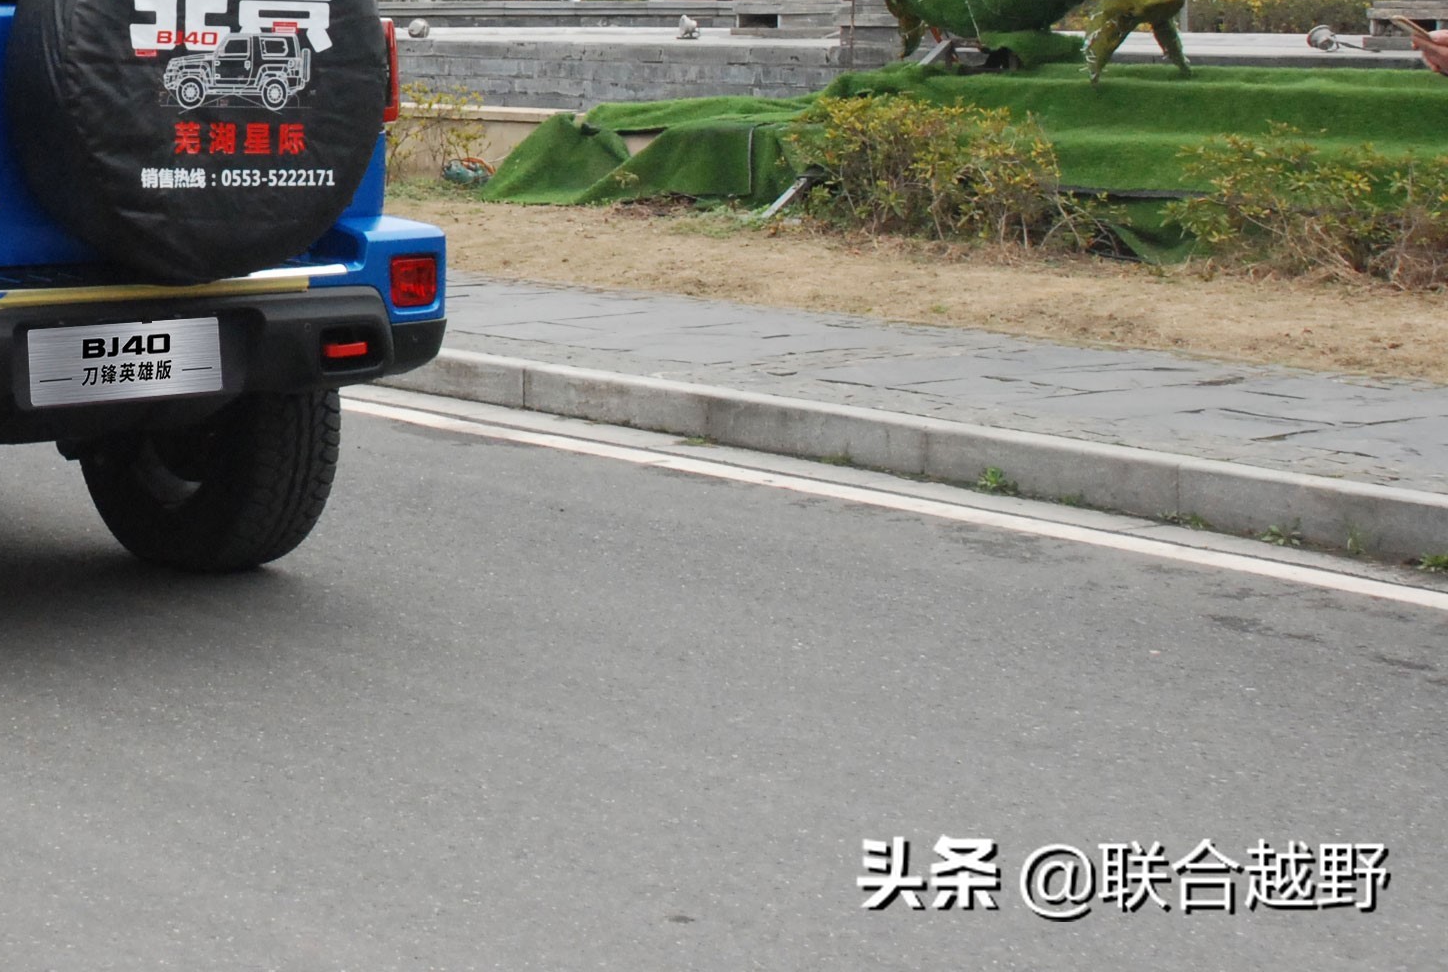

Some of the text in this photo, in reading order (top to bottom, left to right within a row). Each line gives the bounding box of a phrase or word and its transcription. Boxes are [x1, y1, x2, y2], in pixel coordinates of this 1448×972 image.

[157, 30, 218, 46] BJ40
[174, 121, 305, 154] 芜湖星际
[81, 332, 171, 359] BJ40
[81, 359, 172, 386] 刀锋英雄版
